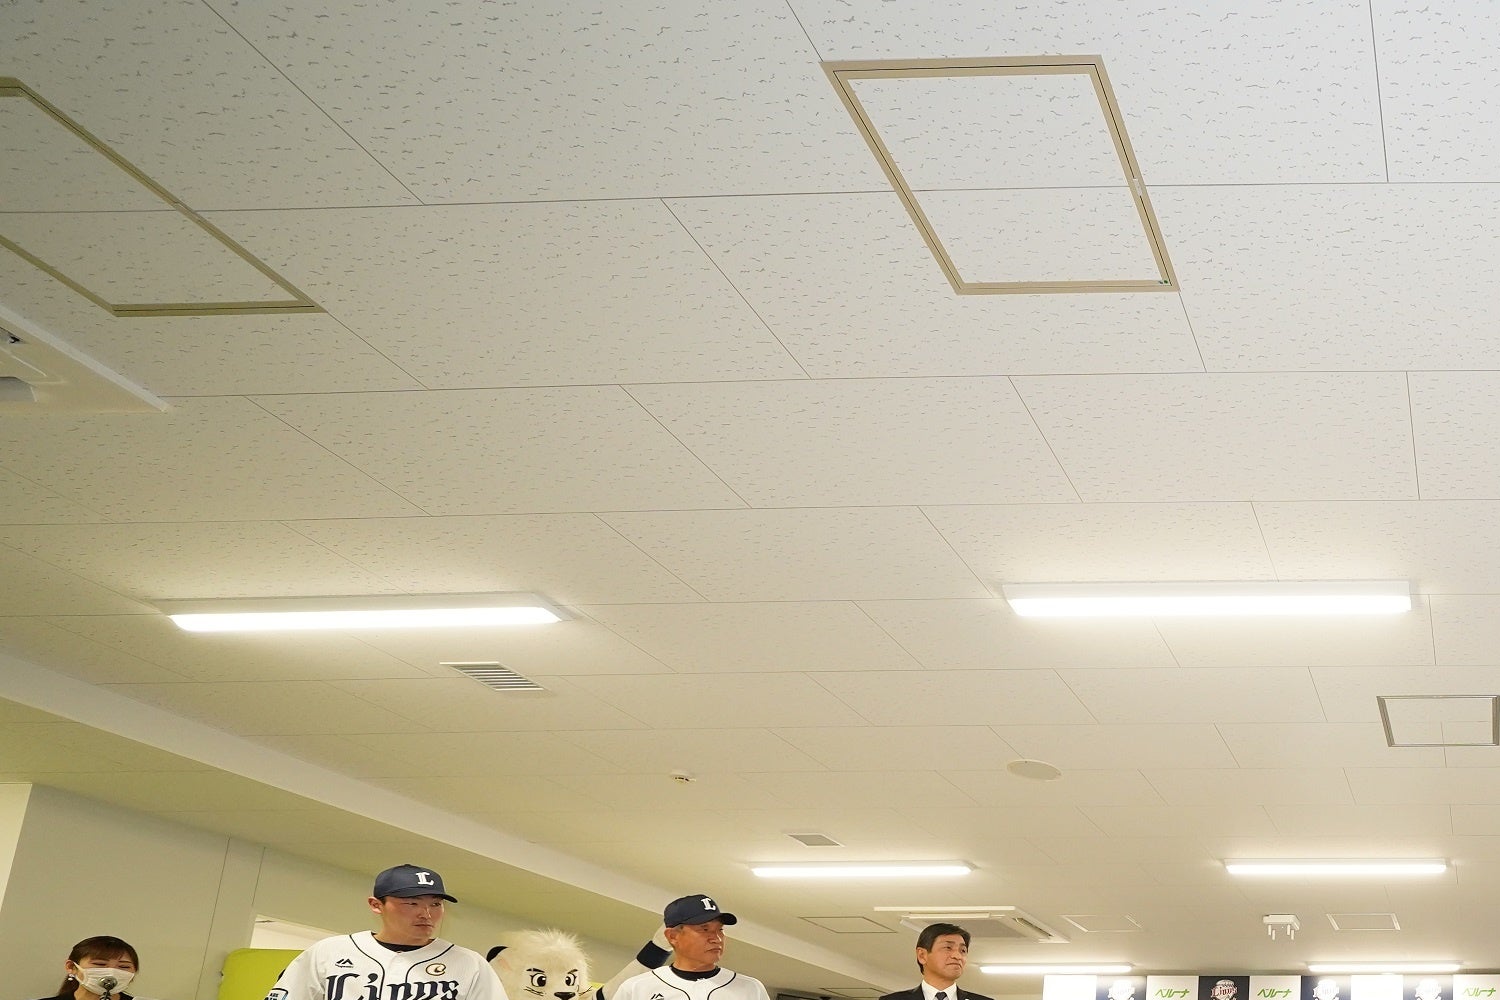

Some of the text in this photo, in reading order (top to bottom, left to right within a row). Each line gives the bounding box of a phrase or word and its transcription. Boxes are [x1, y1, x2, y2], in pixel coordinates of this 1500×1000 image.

[416, 872, 434, 885] L
[701, 898, 716, 911] L
[1155, 989, 1190, 998] ベルーナ
[1257, 989, 1292, 998] ベルーナ
